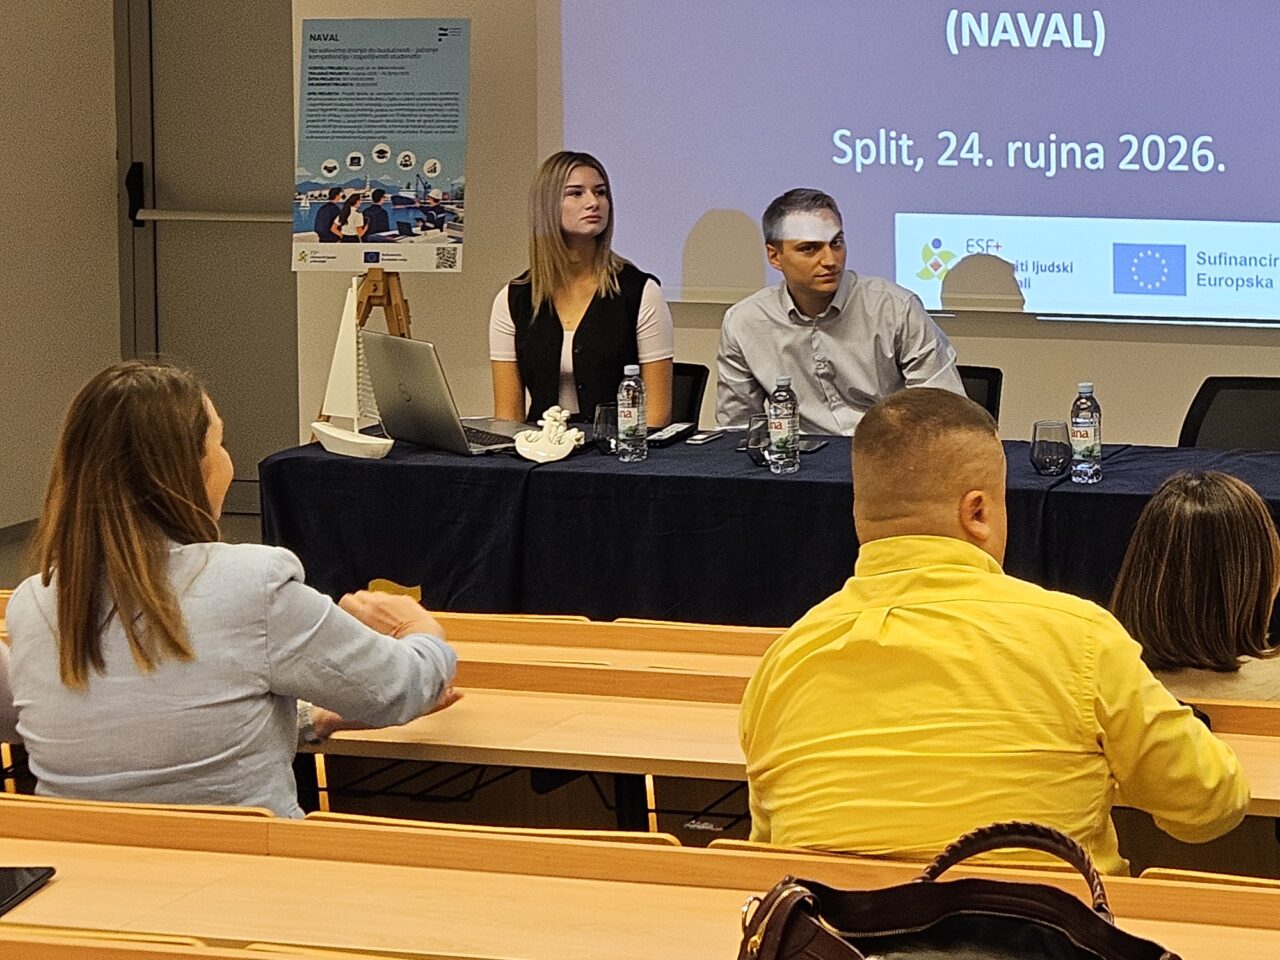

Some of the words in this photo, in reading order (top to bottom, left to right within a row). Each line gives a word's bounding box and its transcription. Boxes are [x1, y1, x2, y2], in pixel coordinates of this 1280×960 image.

[309, 33, 340, 42] NAVAL
[946, 9, 1106, 57] (NAVAL)
[832, 128, 924, 173] Split,
[937, 130, 993, 167] 24.
[1007, 133, 1105, 178] rujna
[1118, 134, 1226, 173] 2026.
[966, 238, 1002, 254] ESF+
[1032, 261, 1074, 275] ljudski
[1196, 273, 1273, 291] Europska
[1071, 429, 1089, 439] ana
